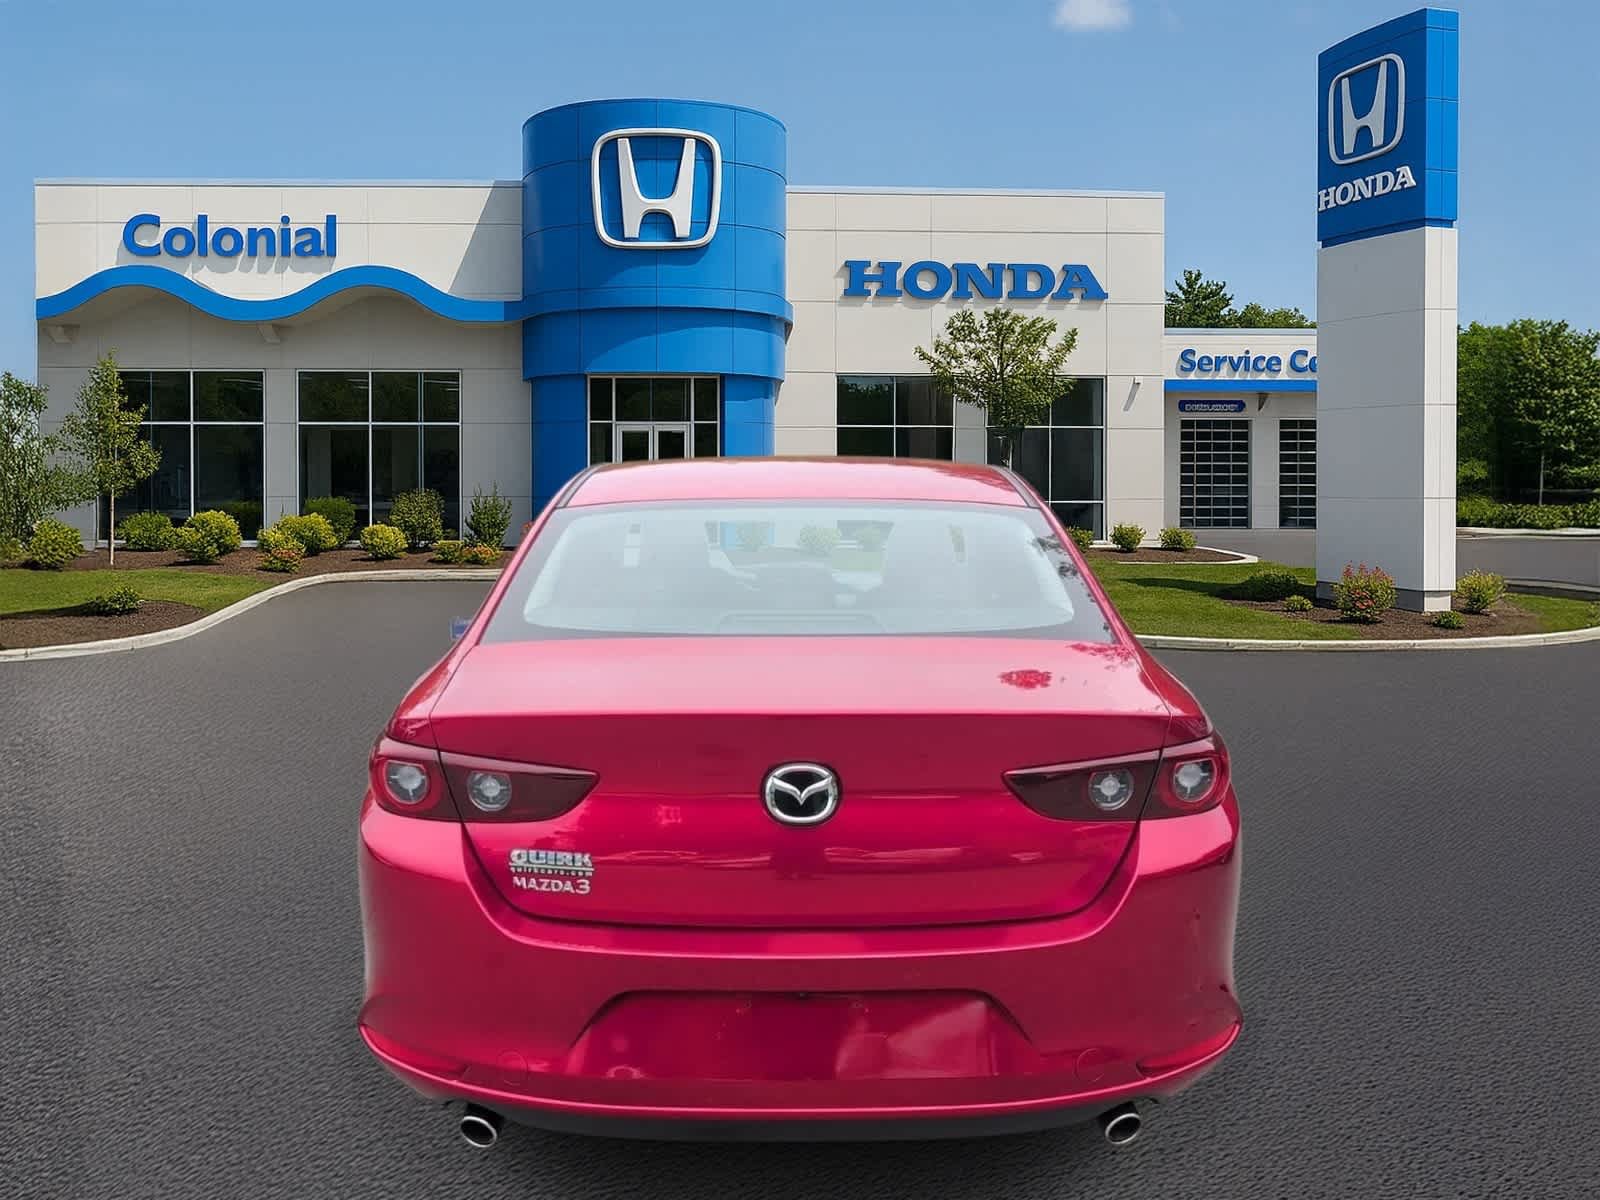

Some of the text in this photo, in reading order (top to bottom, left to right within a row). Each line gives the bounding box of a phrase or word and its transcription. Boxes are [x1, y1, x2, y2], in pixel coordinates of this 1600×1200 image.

[1318, 165, 1416, 212] HONDA
[122, 213, 337, 257] Colonial
[843, 260, 1109, 300] HONDA
[1179, 348, 1282, 373] Service
[509, 848, 593, 867] QUIRK
[512, 876, 591, 894] MAZDA3
